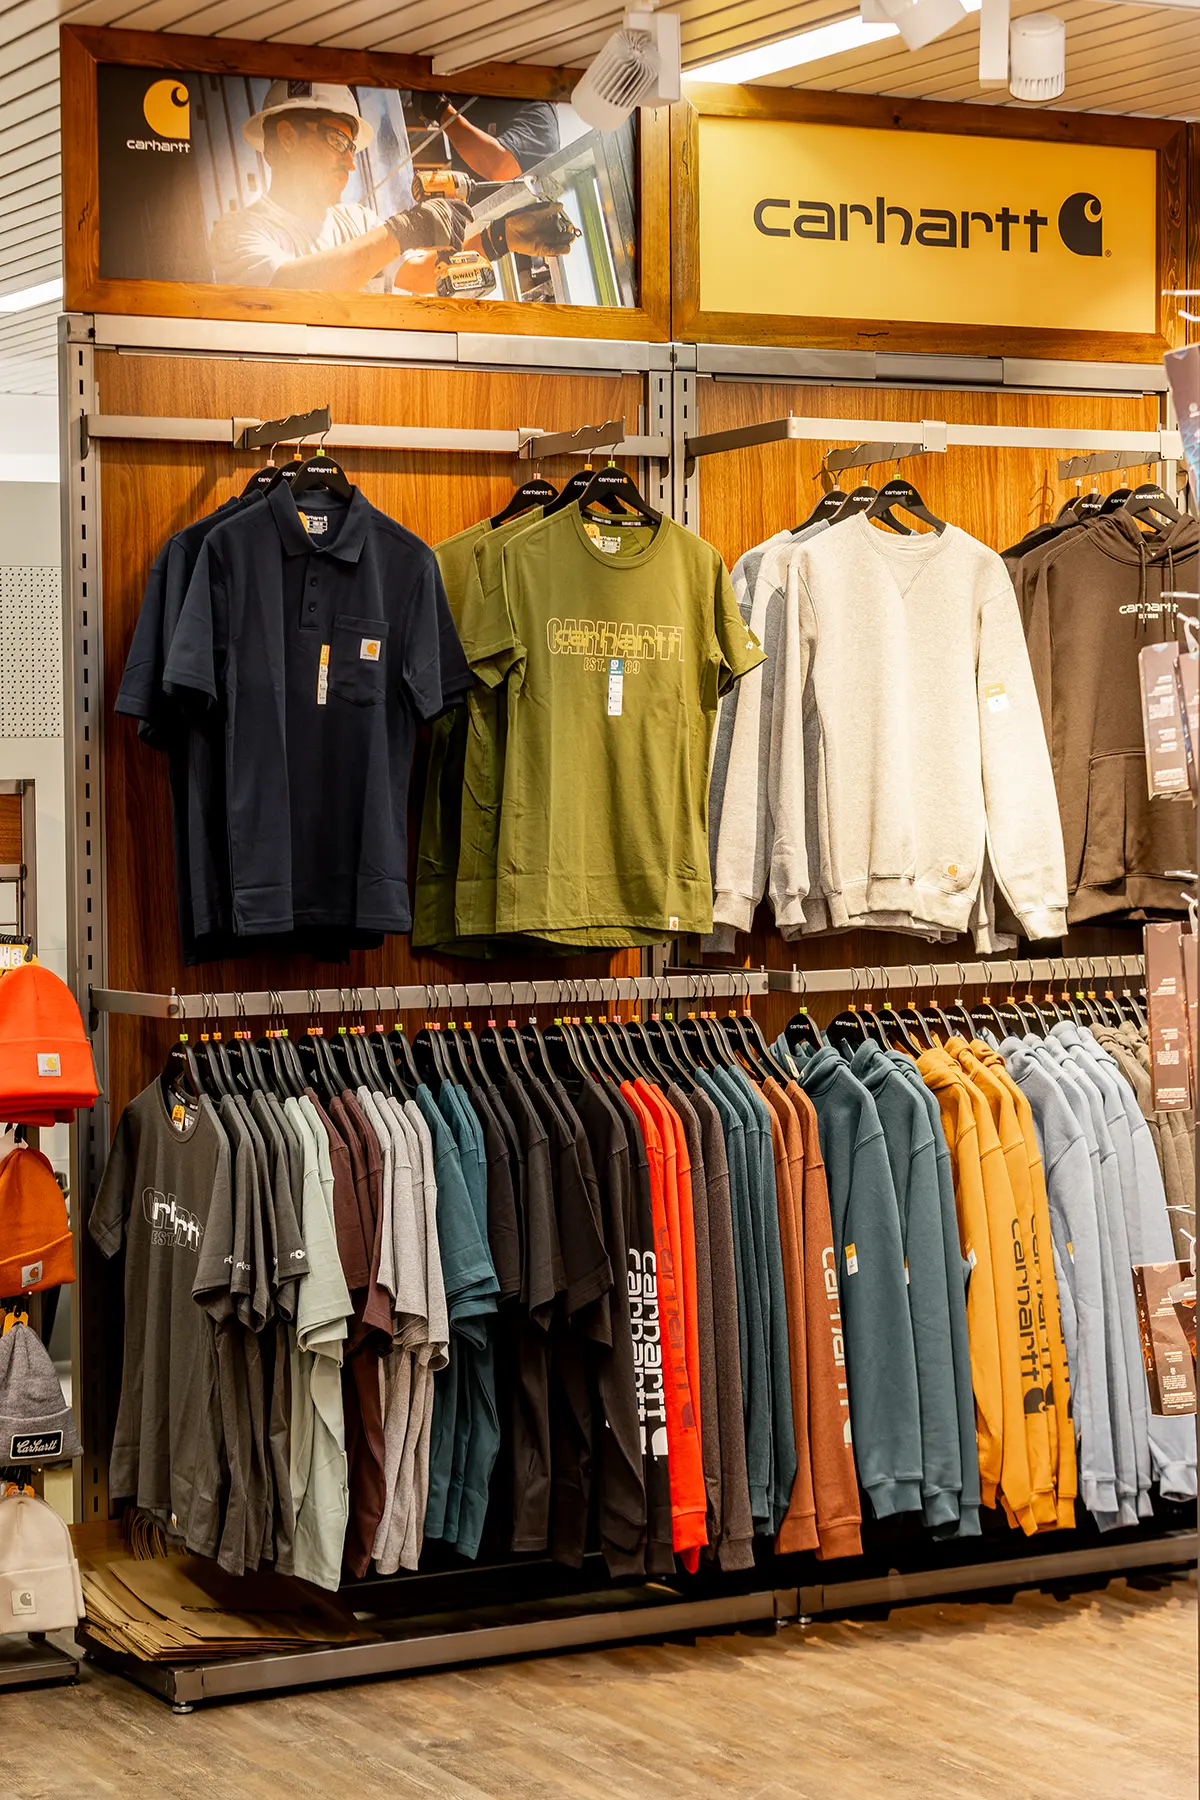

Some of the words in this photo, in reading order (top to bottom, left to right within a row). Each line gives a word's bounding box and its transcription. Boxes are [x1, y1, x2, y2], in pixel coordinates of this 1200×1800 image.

[126, 140, 191, 153] carhartt
[753, 196, 1049, 254] carhartt
[307, 466, 333, 474] carhartt
[598, 476, 623, 484] carhartt
[1011, 1218, 1040, 1382] carhartt
[643, 1250, 667, 1423] carhartt
[16, 1439, 57, 1454] Carhartt
